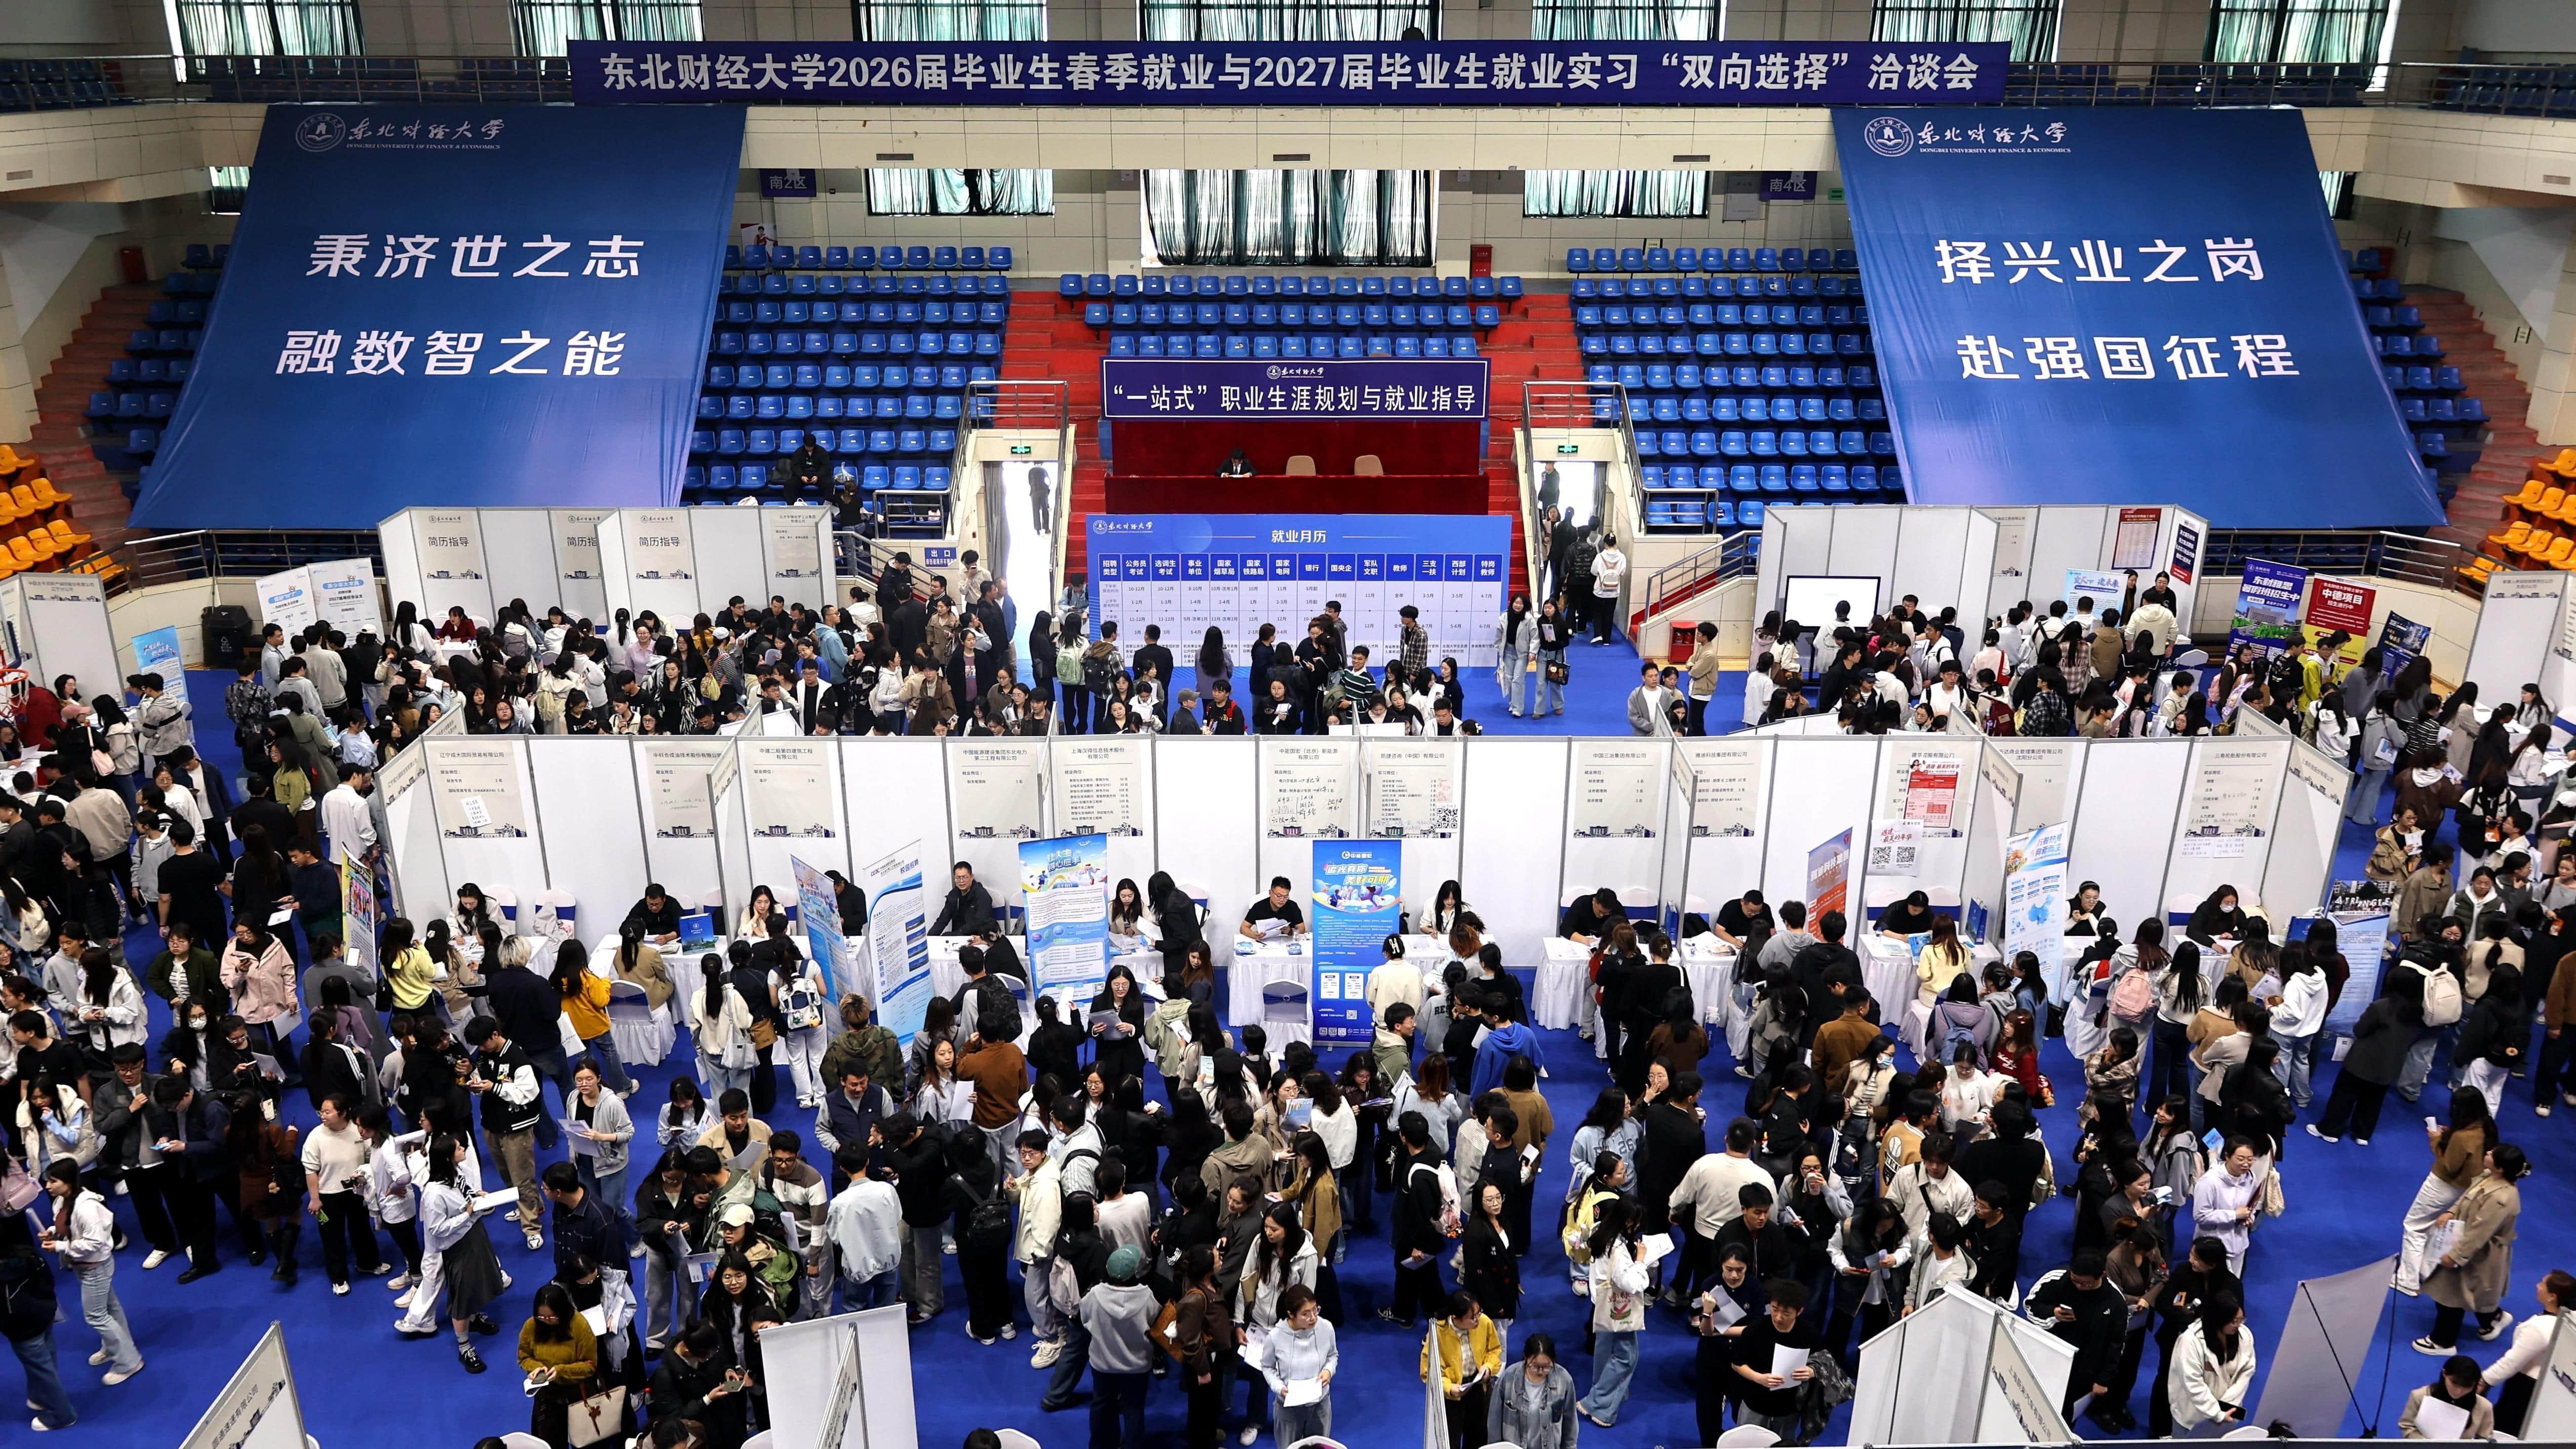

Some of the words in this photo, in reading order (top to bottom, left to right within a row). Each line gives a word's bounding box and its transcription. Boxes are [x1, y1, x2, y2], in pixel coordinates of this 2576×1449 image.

[348, 117, 504, 140] 东北财经大学
[1917, 121, 2067, 145] 东北财经大学
[1769, 178, 1807, 193] 南4区
[306, 234, 645, 278] 秉济世之志
[1934, 237, 2265, 285] 择兴业之岗
[275, 330, 627, 376] 融数智之能
[1955, 333, 2300, 380] 赴强国征程
[1271, 530, 1326, 543] 就业月历
[428, 537, 469, 547] 简历指导
[639, 536, 680, 547] 简历指导
[1103, 559, 1117, 568] 招聘
[1125, 559, 1146, 568] 公务员
[1155, 559, 1176, 568] 选调生
[1188, 559, 1202, 568] 事业
[1217, 559, 1231, 568] 国家
[1246, 559, 1261, 568] 国家
[1276, 559, 1290, 568] 国家
[1364, 559, 1378, 568] 军队
[1422, 559, 1437, 568] 三支
[1452, 559, 1466, 568] 西部
[1481, 559, 1495, 568] 特岗
[1103, 568, 1117, 576] 类型
[1129, 568, 1144, 576] 考试
[1158, 568, 1173, 576] 考试
[1188, 568, 1202, 576] 单位
[1214, 568, 1235, 576] 烟草局
[1243, 568, 1264, 576] 铁路局
[1276, 568, 1290, 576] 电网
[1305, 564, 1319, 573] 银行
[1331, 564, 1352, 573] 国央企
[1364, 568, 1378, 576] 文职
[1393, 564, 1407, 573] 教师
[1422, 568, 1436, 576] 一扶
[1452, 568, 1466, 576] 计划
[1481, 568, 1495, 576] 教师
[2322, 588, 2363, 605] 中德项目
[1046, 848, 1073, 862] 让人生
[1327, 864, 1368, 874] 追光有你
